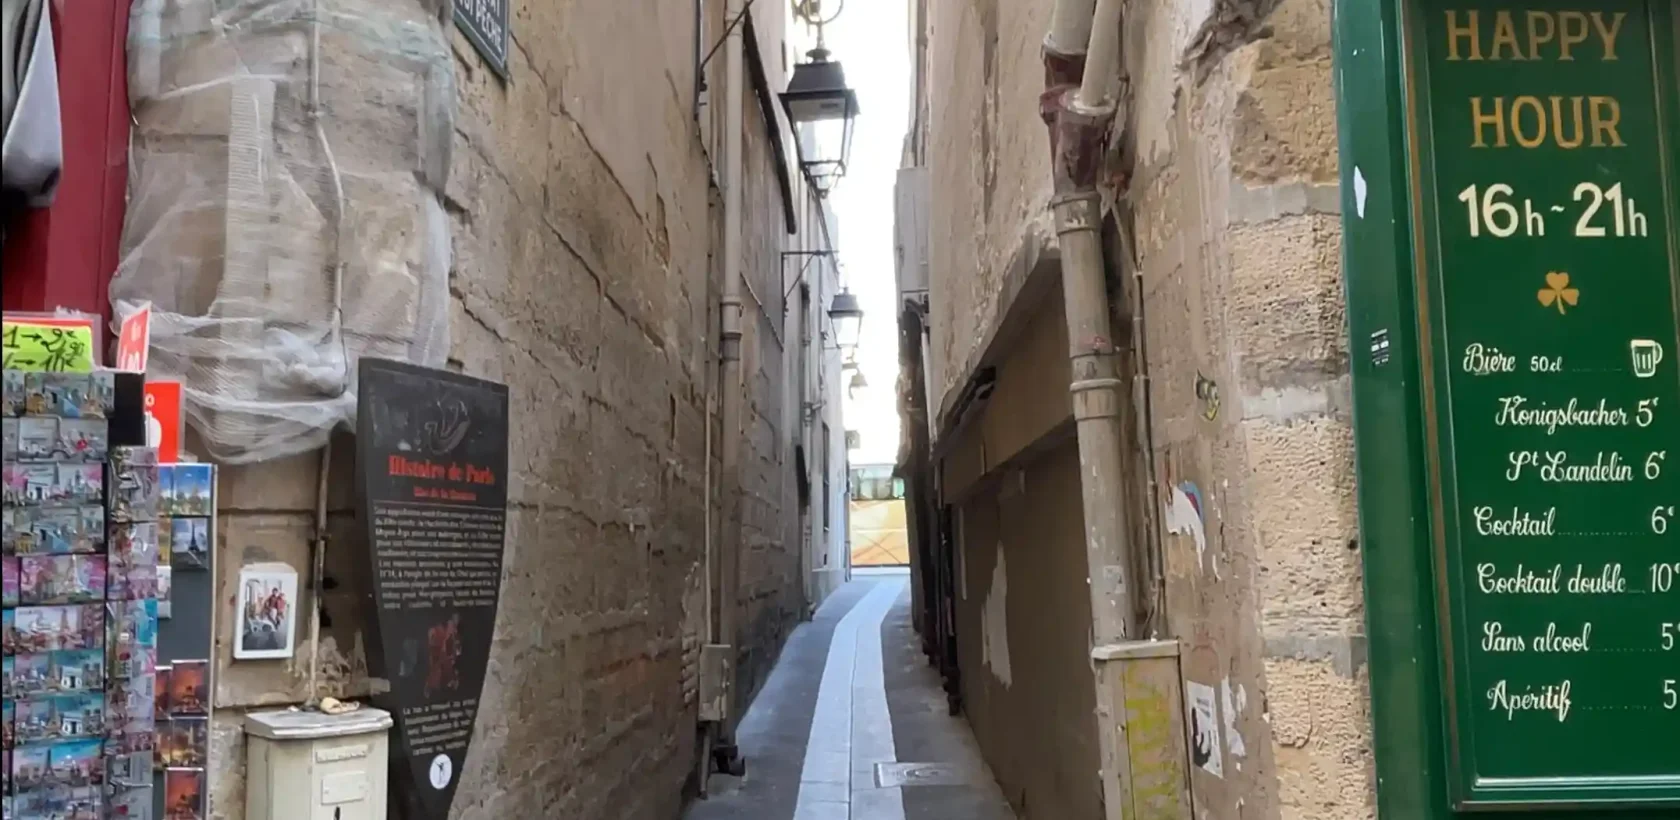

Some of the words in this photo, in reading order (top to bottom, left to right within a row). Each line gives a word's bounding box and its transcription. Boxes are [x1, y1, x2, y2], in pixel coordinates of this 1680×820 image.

[1445, 10, 1628, 61] HAPPY
[1469, 96, 1627, 148] HOUR
[1463, 343, 1516, 375] Bière
[1530, 356, 1562, 372] 50cl
[1495, 395, 1628, 435] Konigsbacher
[448, 462, 461, 480] de
[466, 463, 495, 484] Paris
[1540, 451, 1633, 481] Landelin
[1473, 506, 1556, 536] Cocktail
[1477, 563, 1561, 594] Cocktail
[1567, 563, 1626, 594] double
[1482, 621, 1526, 652] Sans
[1533, 622, 1591, 652] alcool
[1486, 680, 1572, 722] Apéritif
